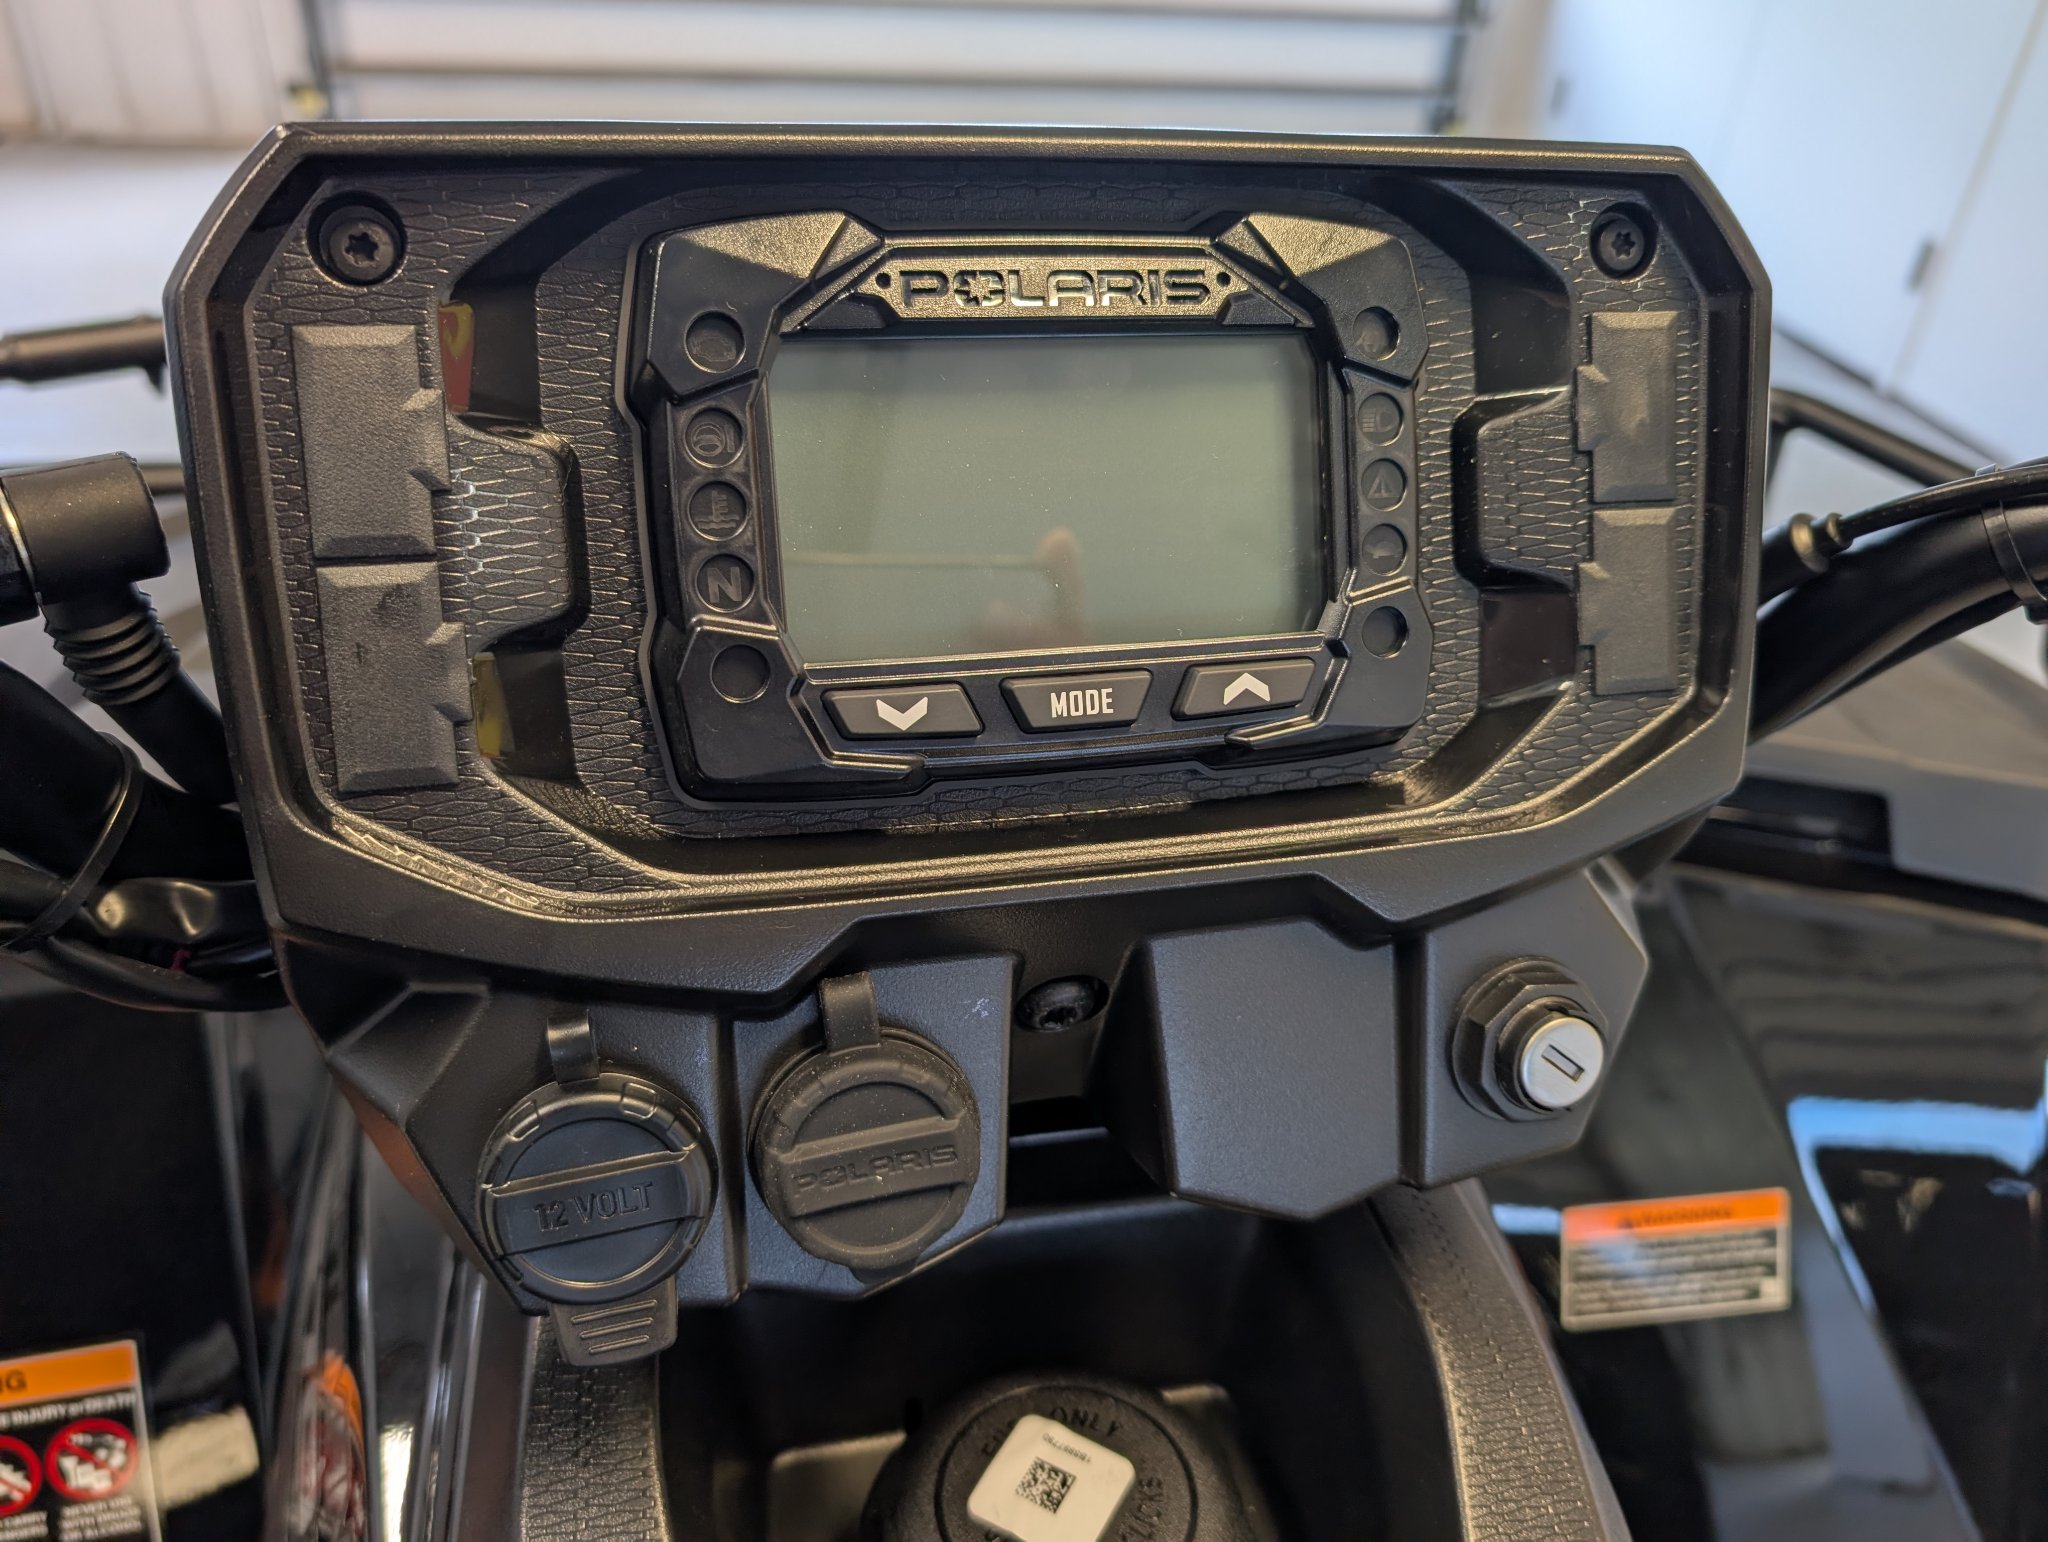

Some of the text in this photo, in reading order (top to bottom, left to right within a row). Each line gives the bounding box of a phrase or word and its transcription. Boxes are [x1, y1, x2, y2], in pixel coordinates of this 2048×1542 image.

[899, 268, 1212, 308] POLARIS
[706, 566, 743, 604] N
[1050, 687, 1114, 719] MODE
[792, 1144, 958, 1198] POLARIS
[533, 1181, 653, 1232] 12 VOLT
